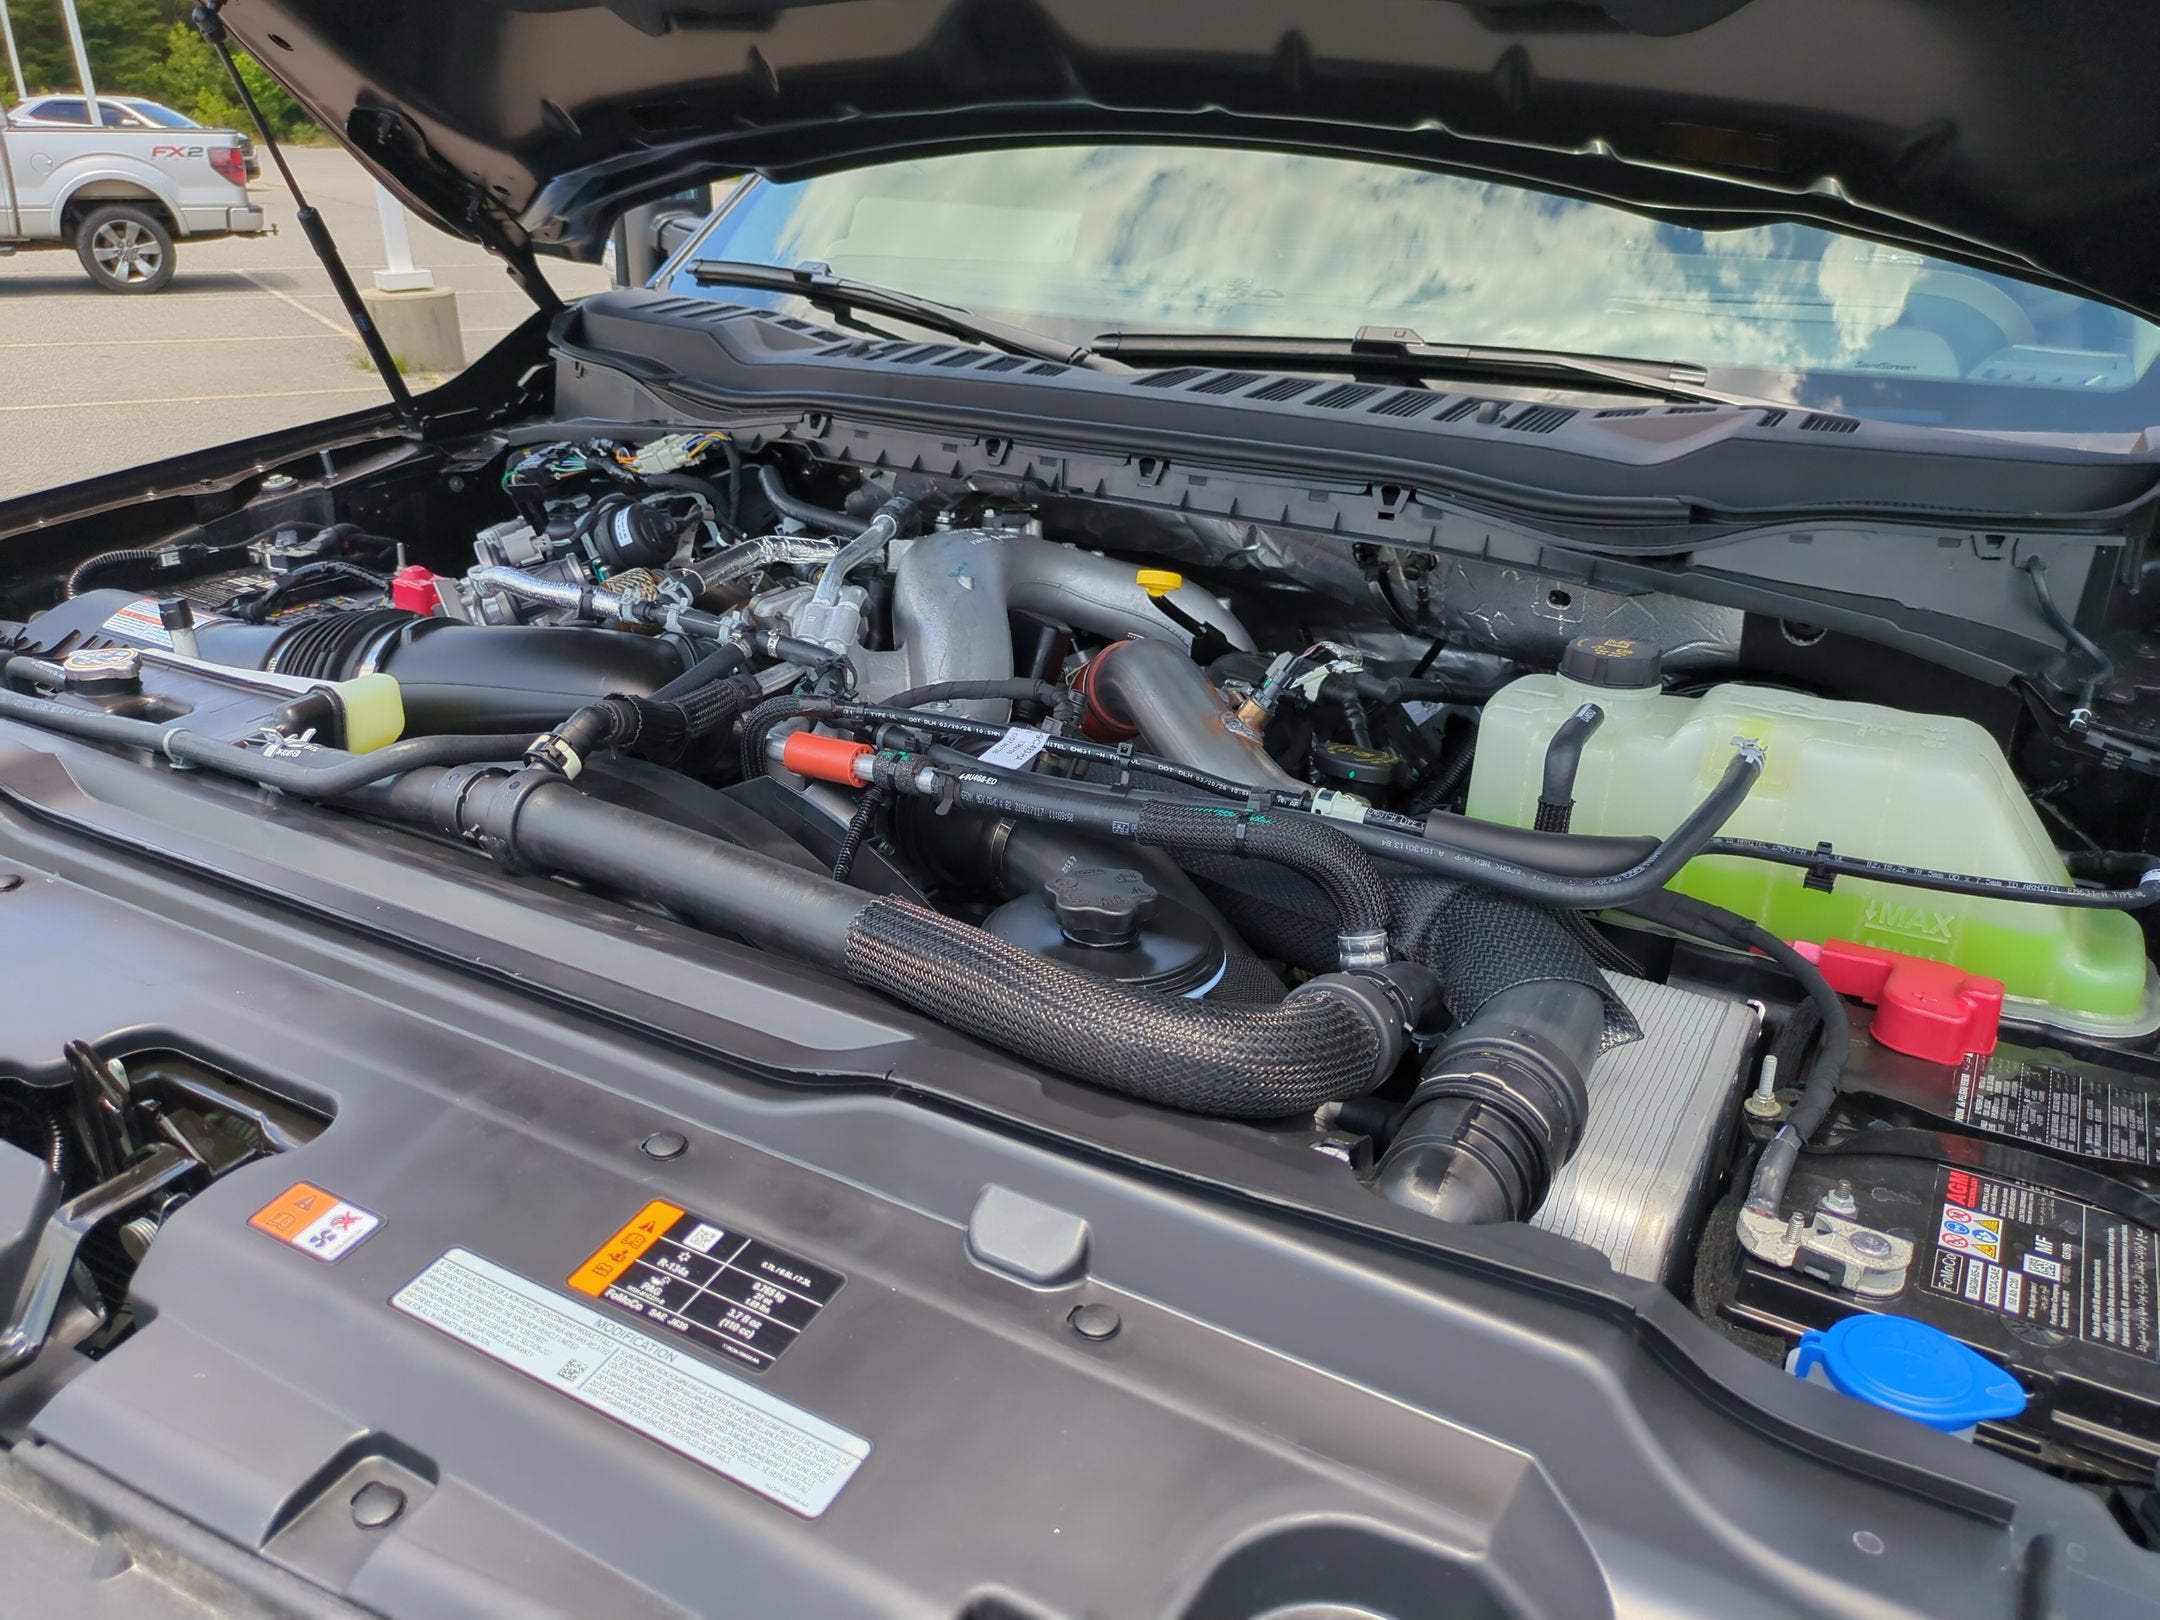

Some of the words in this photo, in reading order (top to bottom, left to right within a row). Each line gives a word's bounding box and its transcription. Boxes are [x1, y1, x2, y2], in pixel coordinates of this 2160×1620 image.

[152, 146, 204, 158] FX2
[1157, 763, 1175, 773] DOT
[1879, 900, 1956, 939] MAX
[1946, 1169, 1969, 1205] AGM
[2034, 1234, 2053, 1255] MF
[654, 1257, 692, 1278] R-134a
[1937, 1250, 1956, 1291] FoMoCo
[638, 1281, 665, 1296] PAG
[750, 1281, 777, 1297] 0.765
[770, 1290, 789, 1303] kg
[602, 1287, 647, 1311] FoMoCo
[646, 1307, 670, 1321] SAE
[715, 1316, 742, 1333] (110
[735, 1325, 757, 1340] cc)
[725, 1307, 745, 1320] 3.7
[747, 1319, 763, 1329] oz
[592, 1317, 679, 1363] MODIFICATION
